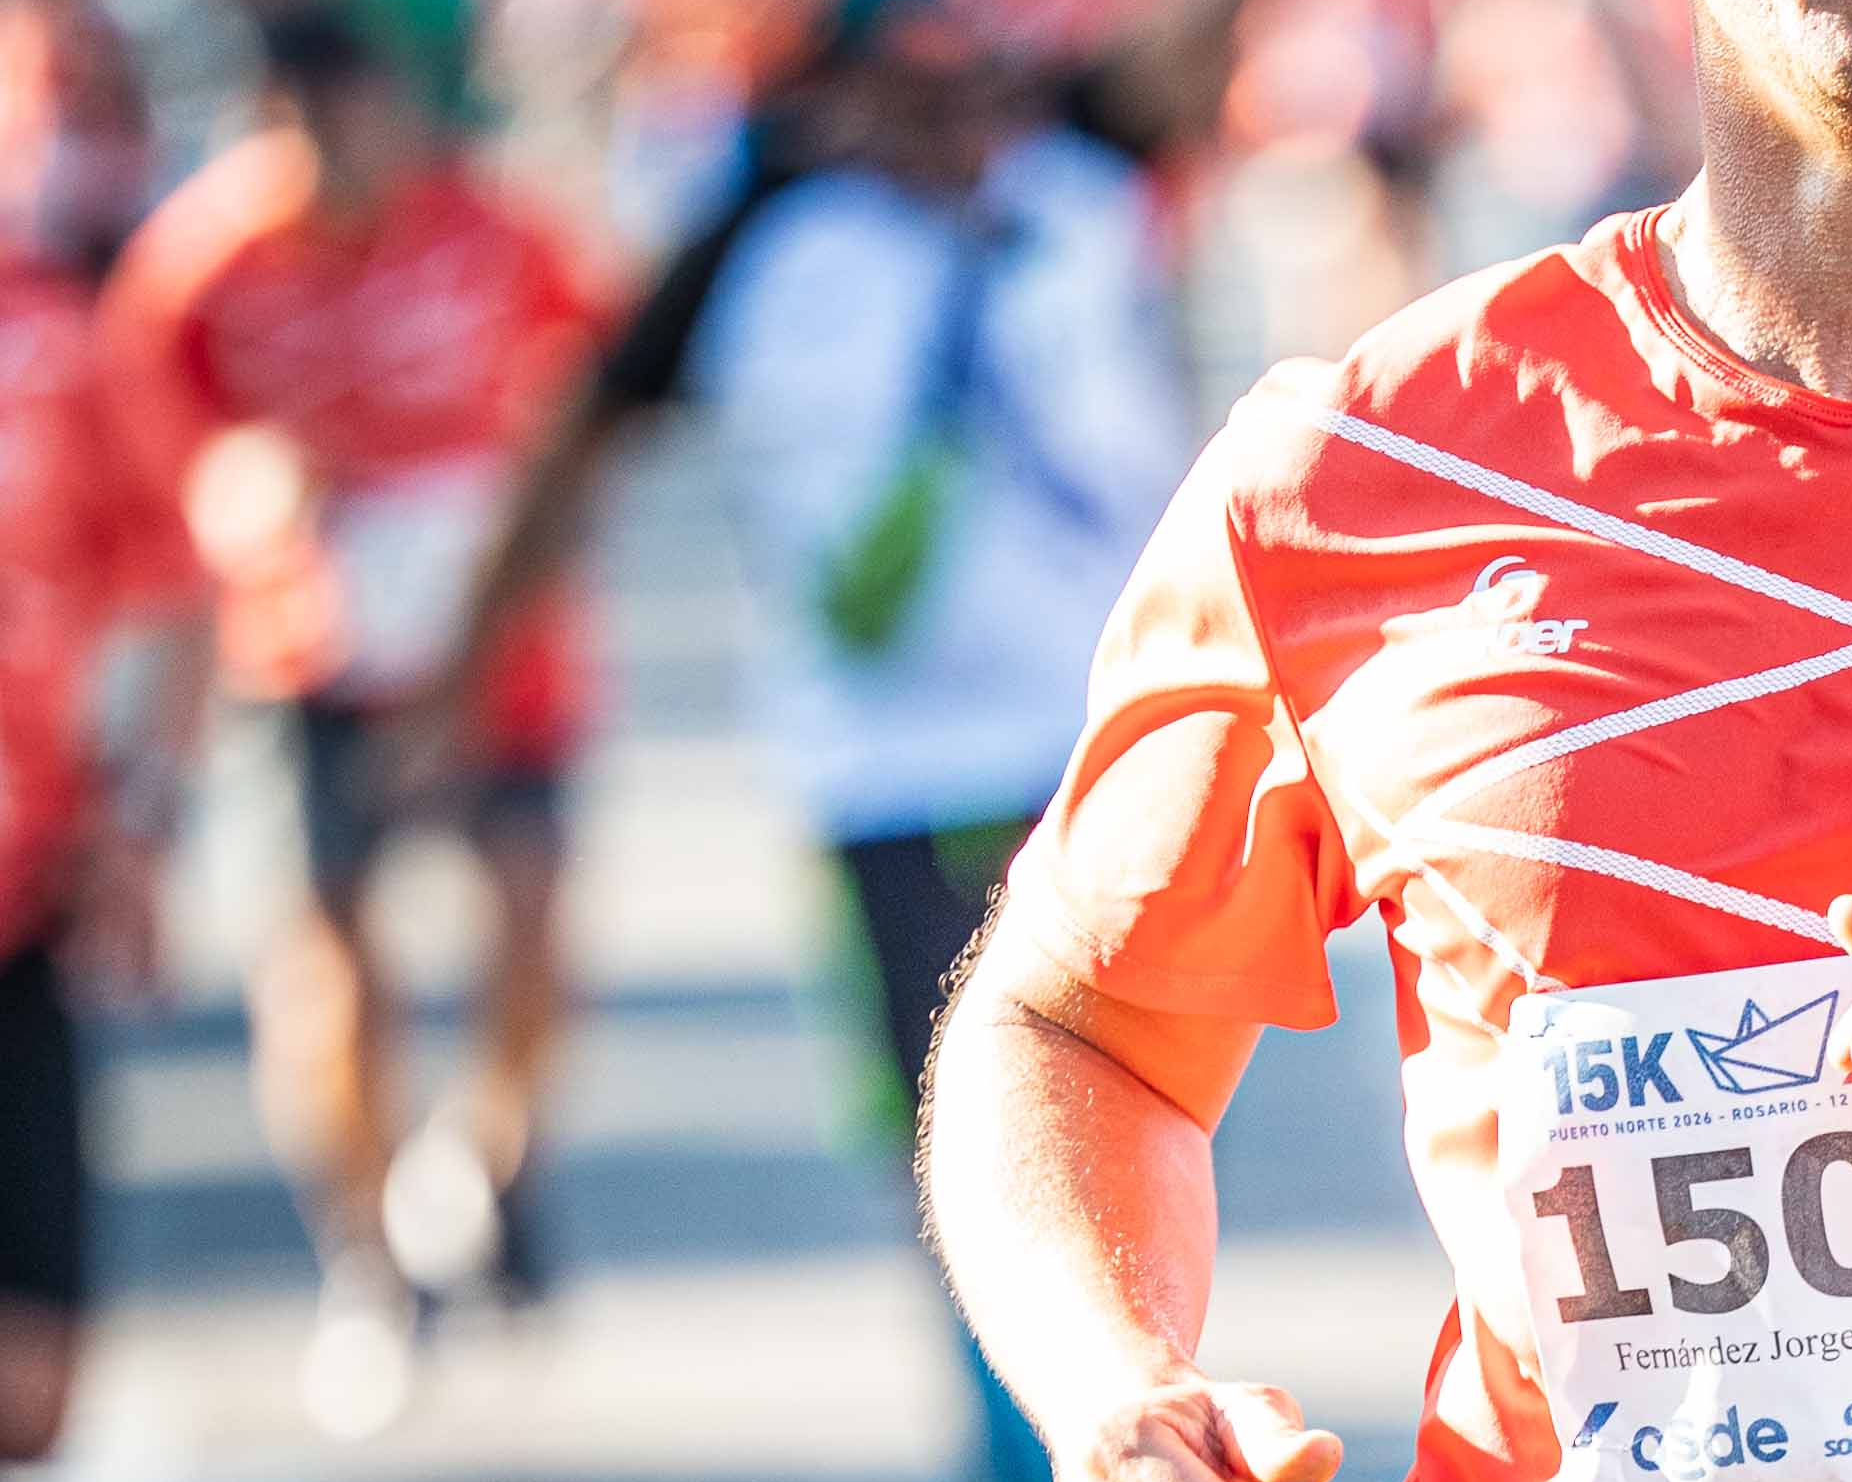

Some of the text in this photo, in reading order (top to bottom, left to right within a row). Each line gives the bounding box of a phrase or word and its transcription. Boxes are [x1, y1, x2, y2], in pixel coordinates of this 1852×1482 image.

[1544, 1032, 1684, 1116] 15K
[1549, 1121, 1609, 1142] PUERTO
[1615, 1118, 1666, 1134] NORTE
[1673, 1112, 1713, 1129] 2026
[1732, 1100, 1808, 1122] ROSARIO
[1829, 1093, 1848, 1108] 12
[1614, 1336, 1761, 1372] Fernández
